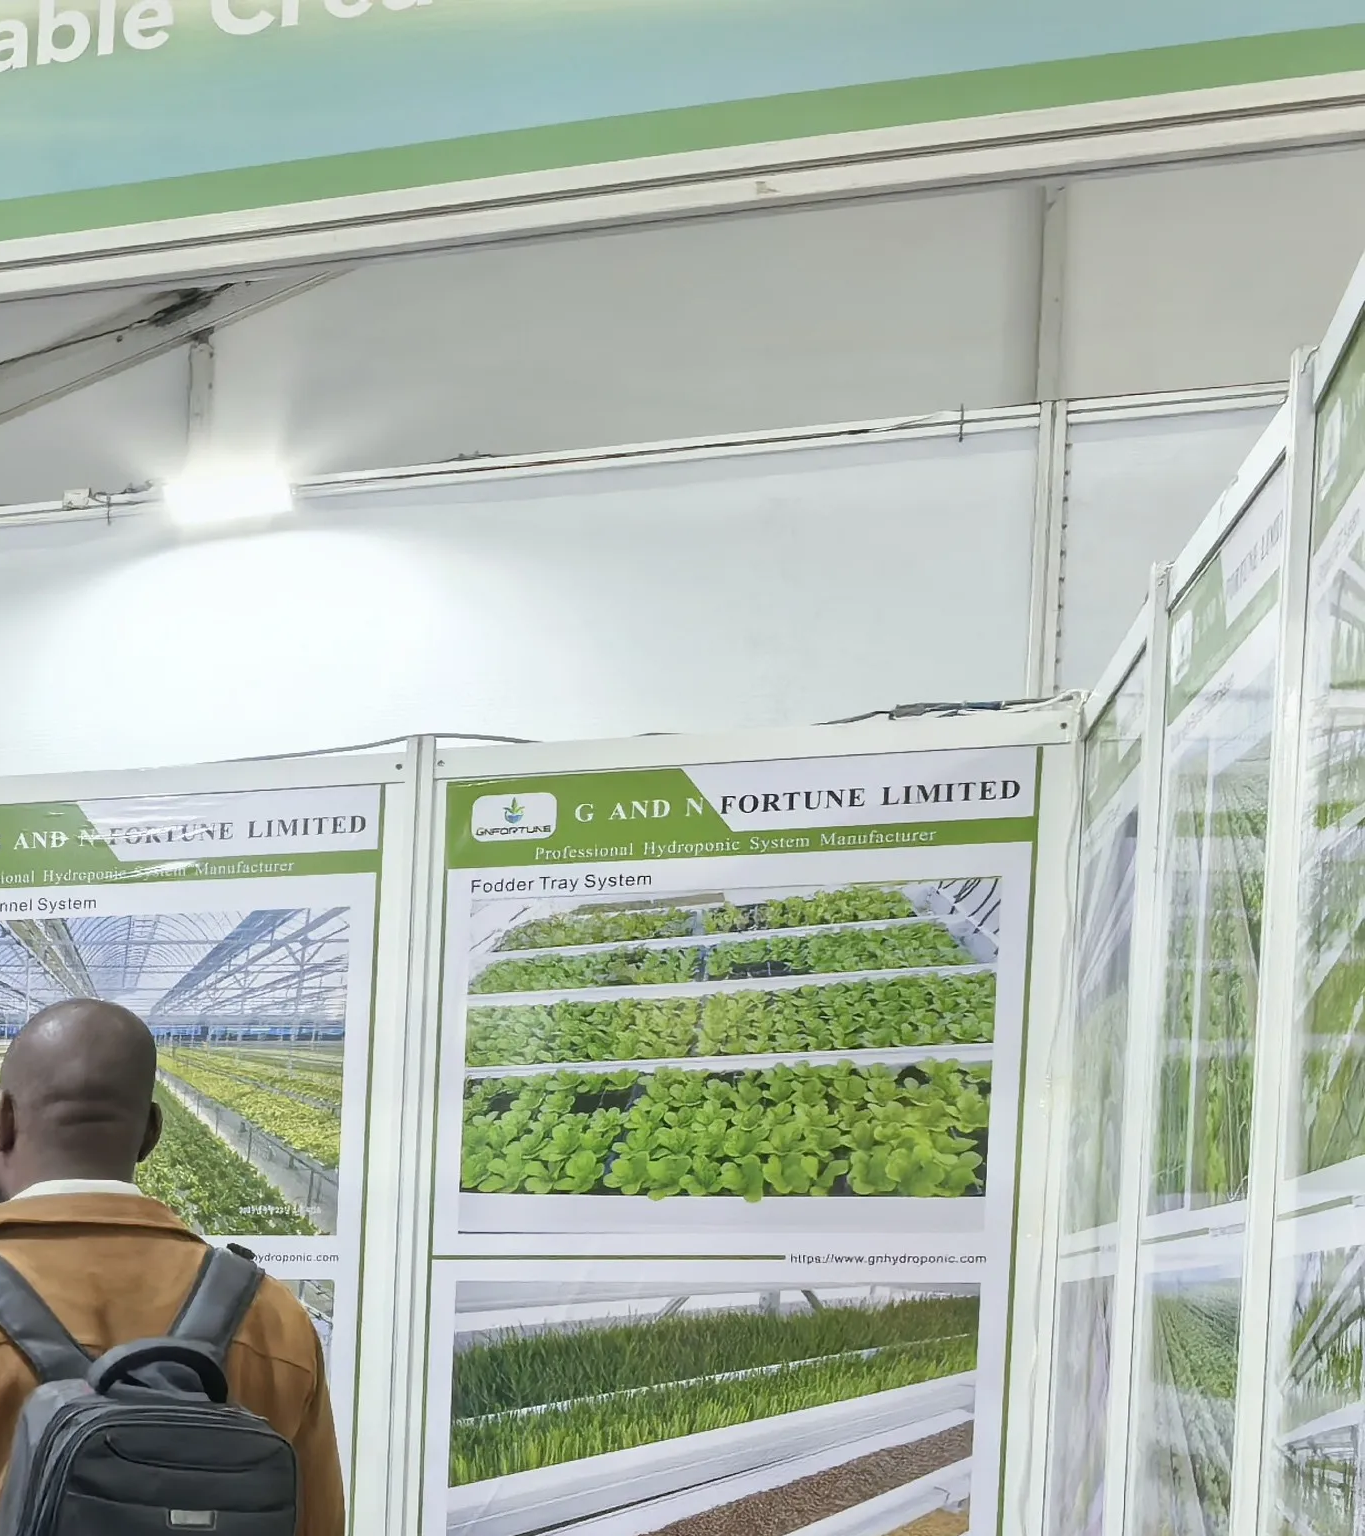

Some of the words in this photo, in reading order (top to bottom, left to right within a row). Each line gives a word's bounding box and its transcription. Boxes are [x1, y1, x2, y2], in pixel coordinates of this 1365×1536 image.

[574, 801, 594, 823] G
[609, 798, 670, 821] AND
[684, 796, 705, 817] N
[720, 788, 866, 816] FORTUNE
[880, 778, 1021, 807] LIMITED
[14, 830, 66, 850] AND
[108, 821, 233, 845] FORTUNE
[247, 814, 367, 840] LIMITED
[534, 842, 634, 861] Professional
[642, 839, 741, 859] Hydroponic
[750, 834, 810, 853] System
[819, 829, 937, 848] Manufacturer
[194, 859, 295, 876] Manufacturer
[470, 876, 534, 894] Fodder
[538, 875, 579, 893] Tray
[584, 872, 653, 892] System
[37, 896, 97, 915] System
[255, 1253, 339, 1263] ydroponic.com
[790, 1253, 987, 1266] https://www.gnhydroponic.com
